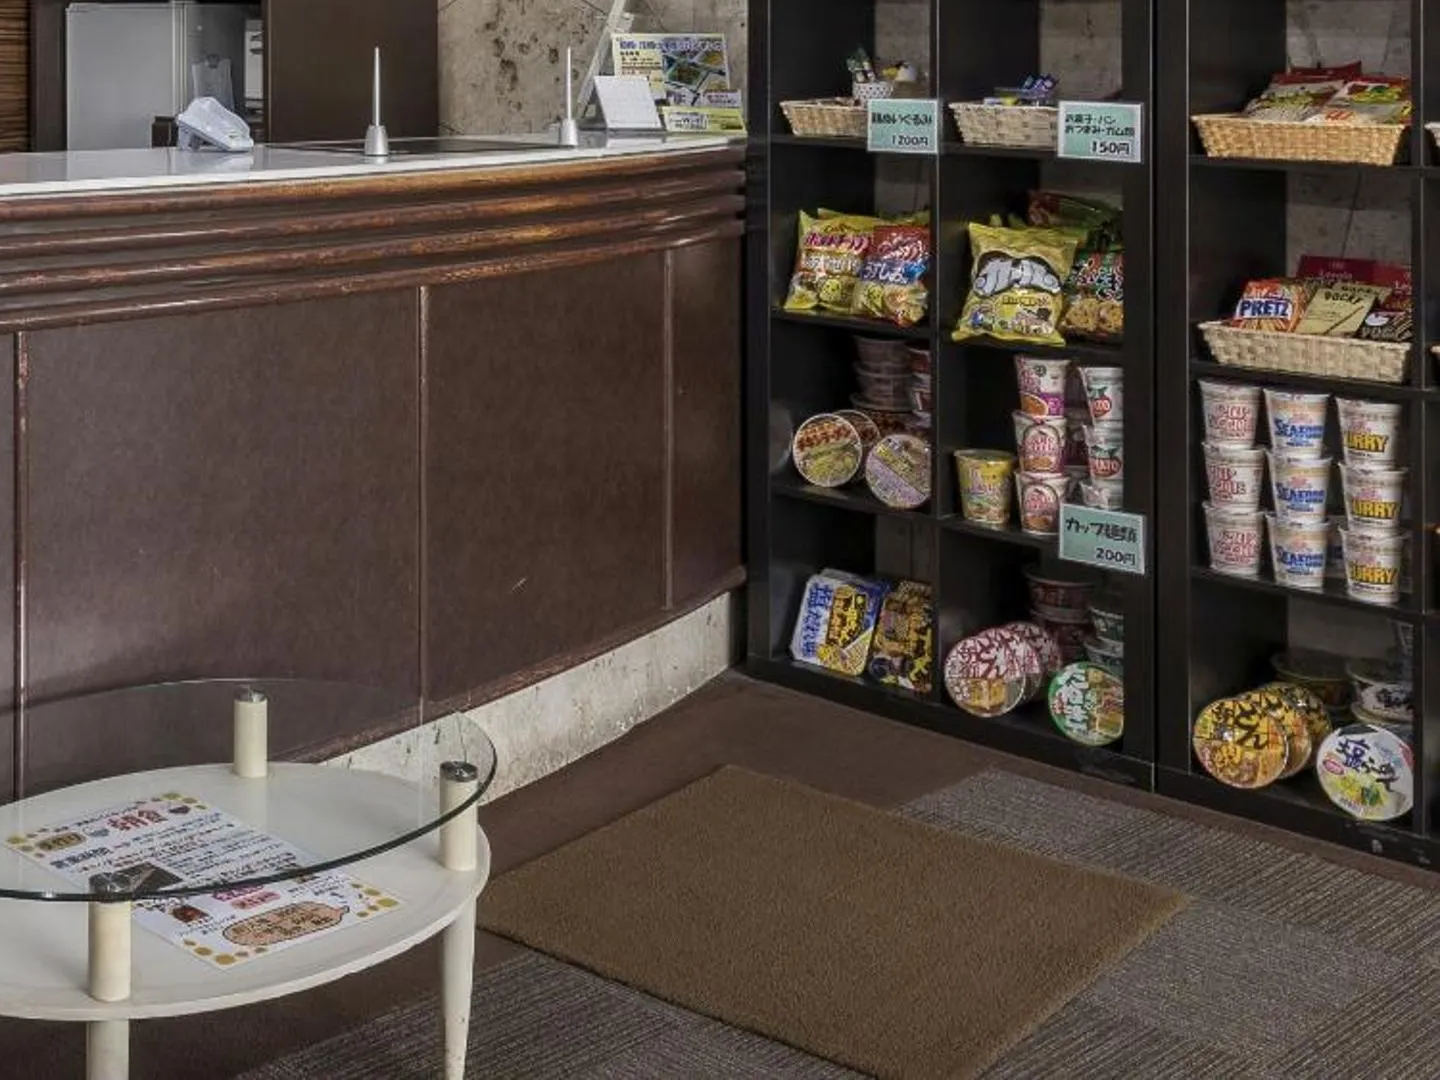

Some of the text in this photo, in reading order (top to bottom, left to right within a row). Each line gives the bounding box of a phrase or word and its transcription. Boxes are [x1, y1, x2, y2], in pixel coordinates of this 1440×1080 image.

[892, 135, 929, 147] 1200円
[1092, 141, 1130, 156] 150円
[1240, 300, 1290, 316] PRETZ
[1096, 548, 1136, 566] 200円
